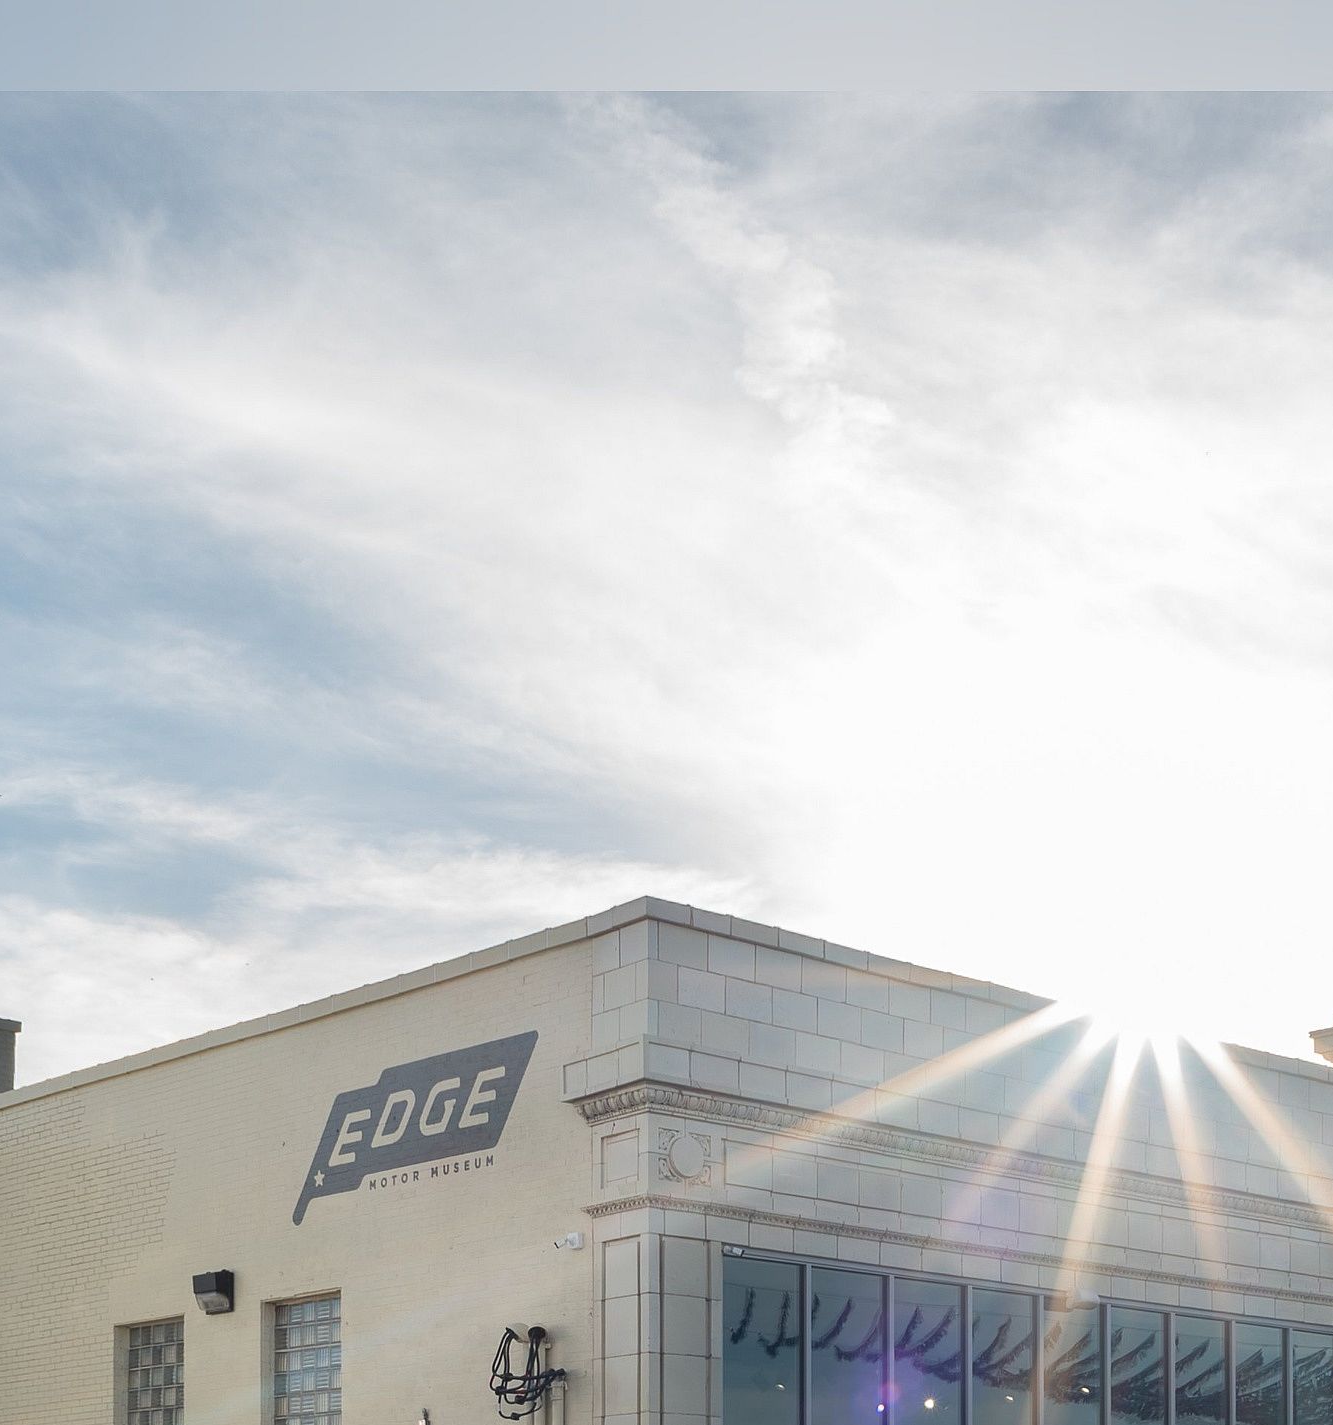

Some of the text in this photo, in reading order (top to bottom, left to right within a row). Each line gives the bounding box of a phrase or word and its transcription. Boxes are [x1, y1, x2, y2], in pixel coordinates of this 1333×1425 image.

[328, 1066, 506, 1167] EDGE
[369, 1155, 495, 1191] MOTOR MUSEUM
